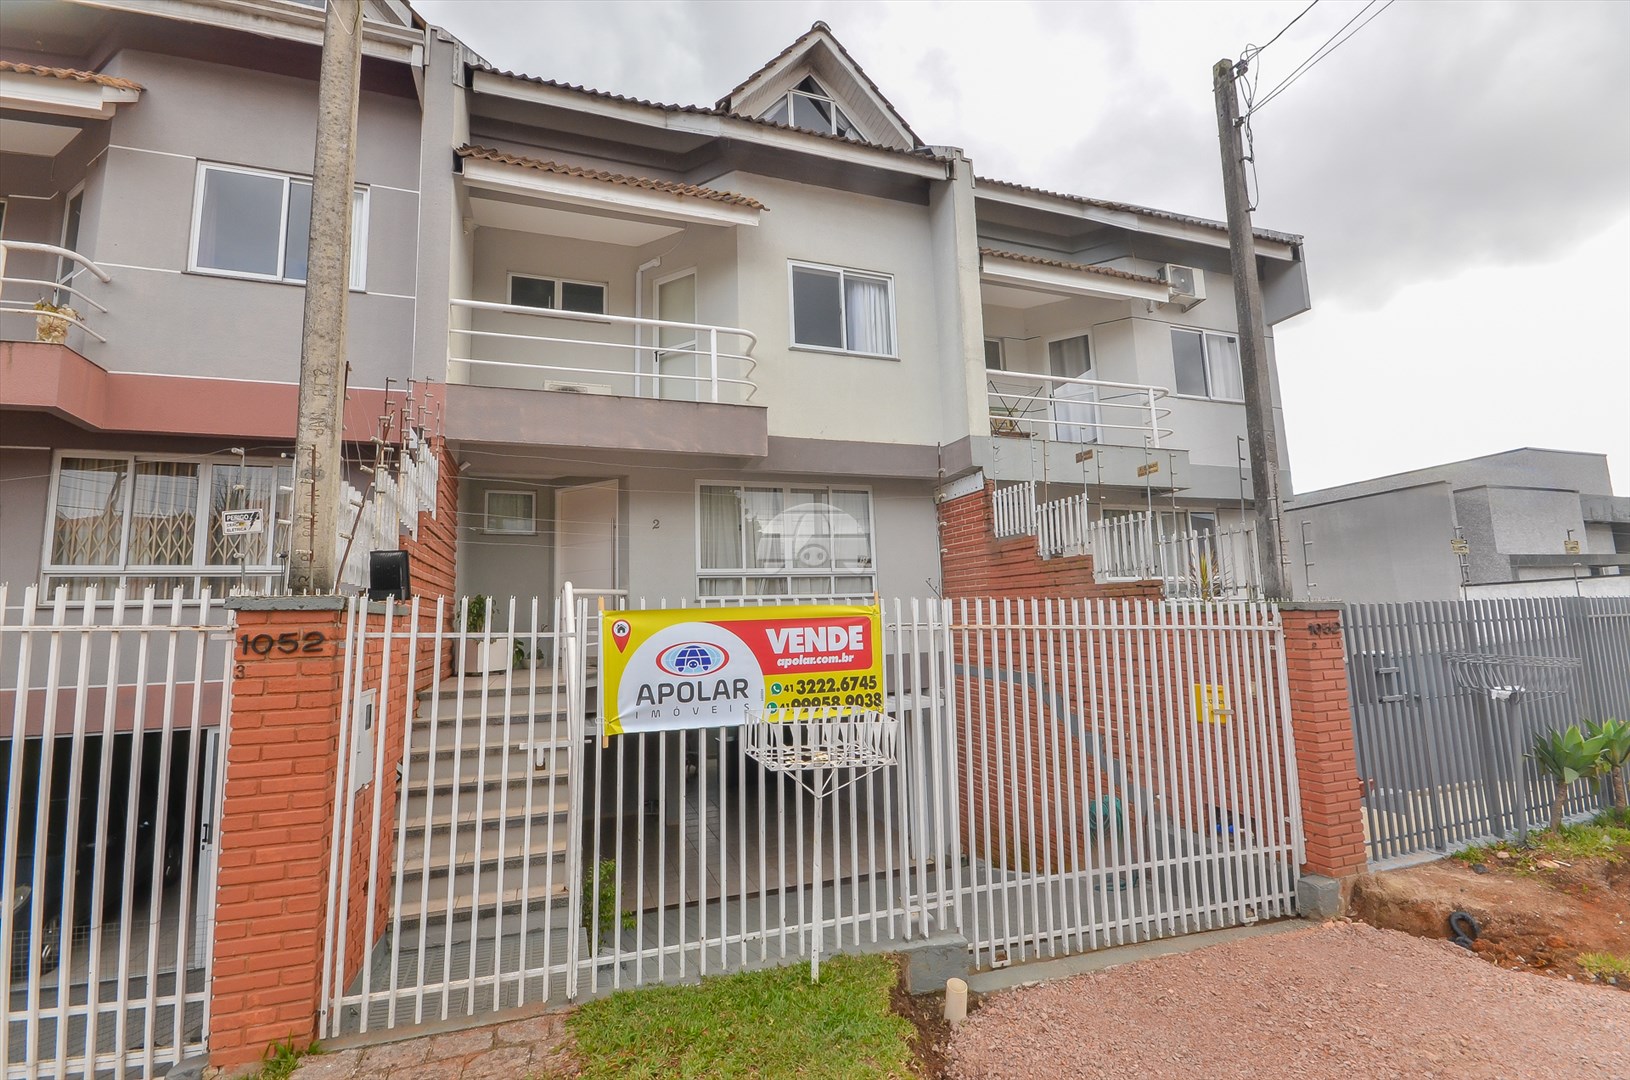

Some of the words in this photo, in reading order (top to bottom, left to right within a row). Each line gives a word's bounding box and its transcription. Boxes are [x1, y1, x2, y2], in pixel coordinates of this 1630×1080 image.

[652, 519, 660, 530] 2
[240, 631, 326, 656] 1052
[765, 625, 864, 654] VENDE
[776, 652, 855, 669] apolar.com.br
[235, 665, 246, 680] 3
[635, 678, 749, 706] APOLAR
[783, 684, 794, 693] 41
[796, 675, 877, 695] 3222.6745
[635, 703, 750, 719] IMÓVEIS
[791, 692, 882, 713] 999589038
